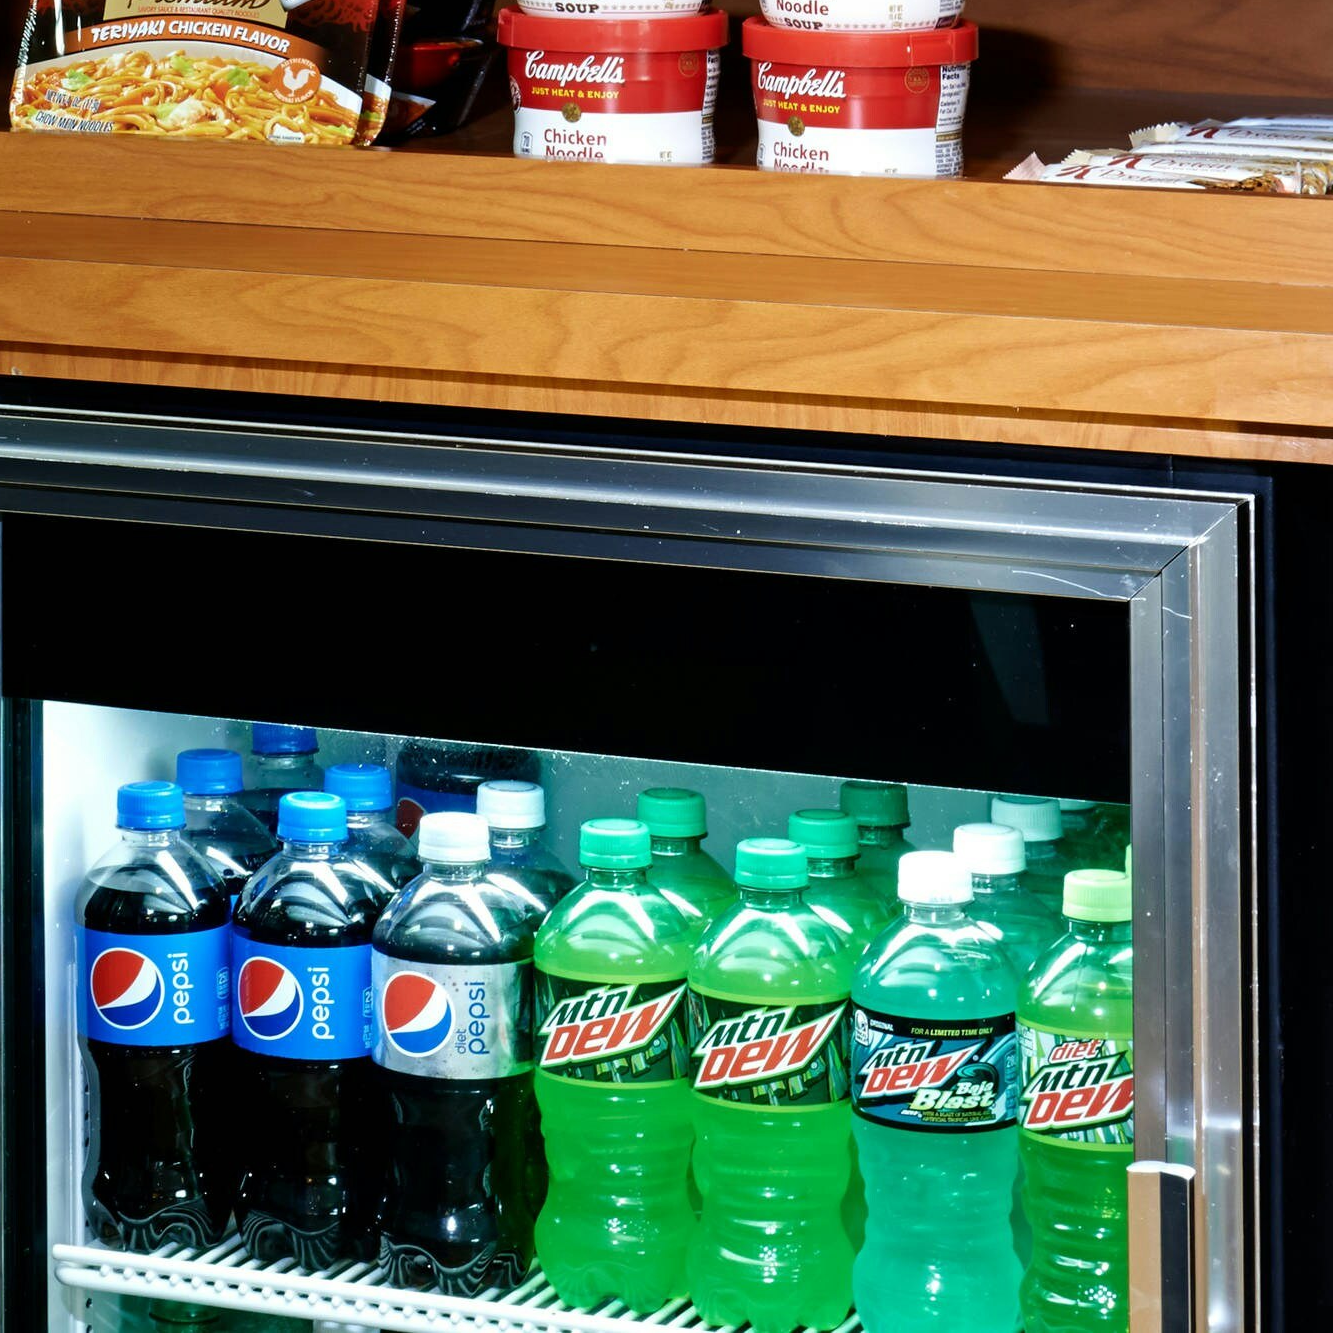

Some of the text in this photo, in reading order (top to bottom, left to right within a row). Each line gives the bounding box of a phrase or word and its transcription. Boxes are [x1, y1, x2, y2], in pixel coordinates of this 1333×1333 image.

[555, 3, 600, 14] SOUP
[784, 18, 824, 29] SOUP
[91, 19, 291, 53] TERIYAKI CHICKEN FLAVOR
[525, 50, 625, 87] Campbell's
[757, 61, 847, 99] Campbell's
[36, 111, 114, 132] CHOW MEIN NOODLES
[543, 129, 607, 146] Chicken
[773, 141, 829, 161] Chicken
[167, 951, 195, 1025] pepsi
[307, 965, 335, 1040] pepsi
[464, 980, 491, 1055] pepsi
[548, 988, 630, 1027] Mtn
[454, 1027, 467, 1054] diet
[544, 992, 680, 1061] DEW
[702, 1010, 781, 1049] Mtn
[911, 1026, 993, 1037] FOR A LIMITED TIME ONLY
[699, 1014, 838, 1083] DEW
[867, 1044, 927, 1070] Mtn
[1050, 1041, 1099, 1063] diet
[865, 1050, 973, 1094] DEW
[955, 1080, 994, 1096] Baja
[1028, 1060, 1107, 1094] Mtn
[909, 1087, 996, 1111] Blast
